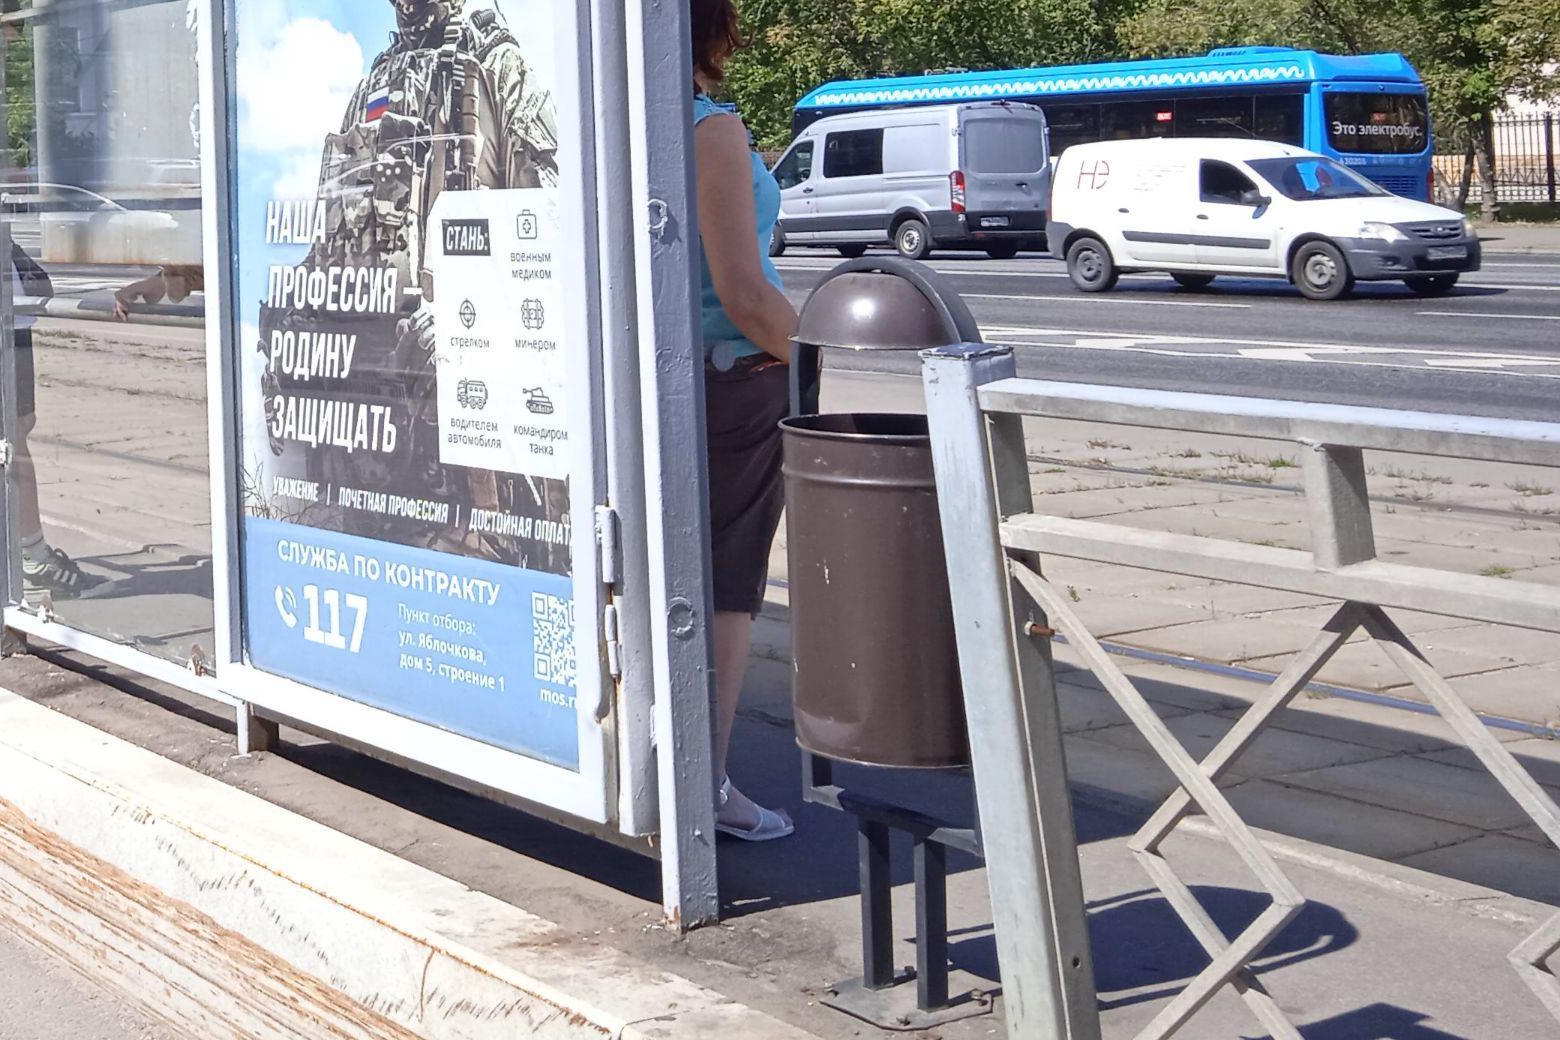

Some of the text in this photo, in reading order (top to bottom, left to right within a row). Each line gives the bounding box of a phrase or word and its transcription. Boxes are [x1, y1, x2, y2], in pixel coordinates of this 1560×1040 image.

[1332, 121, 1357, 135] Это
[265, 200, 327, 244] НАША
[446, 225, 488, 251] СТАНЬ:
[510, 252, 552, 262] военным
[511, 268, 552, 281] медиком
[267, 266, 398, 314] ПРОФЕССИЯ
[269, 331, 357, 381] РОДИНУ
[450, 336, 490, 350] стрелком
[514, 337, 557, 352] минером
[271, 394, 398, 454] ЗАЩИЩАТЬ
[450, 417, 499, 432] водителем
[513, 424, 569, 442] командиром
[447, 433, 502, 449] автомобиля
[529, 442, 554, 456] танка
[272, 475, 319, 503] УВАЖЕНИЕ
[338, 486, 387, 515] ПОЧЕТНАЯ
[388, 494, 449, 523] ПРОФЕССИЯ
[468, 509, 533, 539] ДОСТОЙНАЯ
[277, 540, 501, 606] СЛУЖБА ПО КОНТРАКТУ
[302, 584, 368, 654] 117
[397, 604, 477, 636] Пункт отбора:
[398, 633, 487, 667] ул. Яблочкова,
[399, 653, 506, 693] дом 5, строение 1
